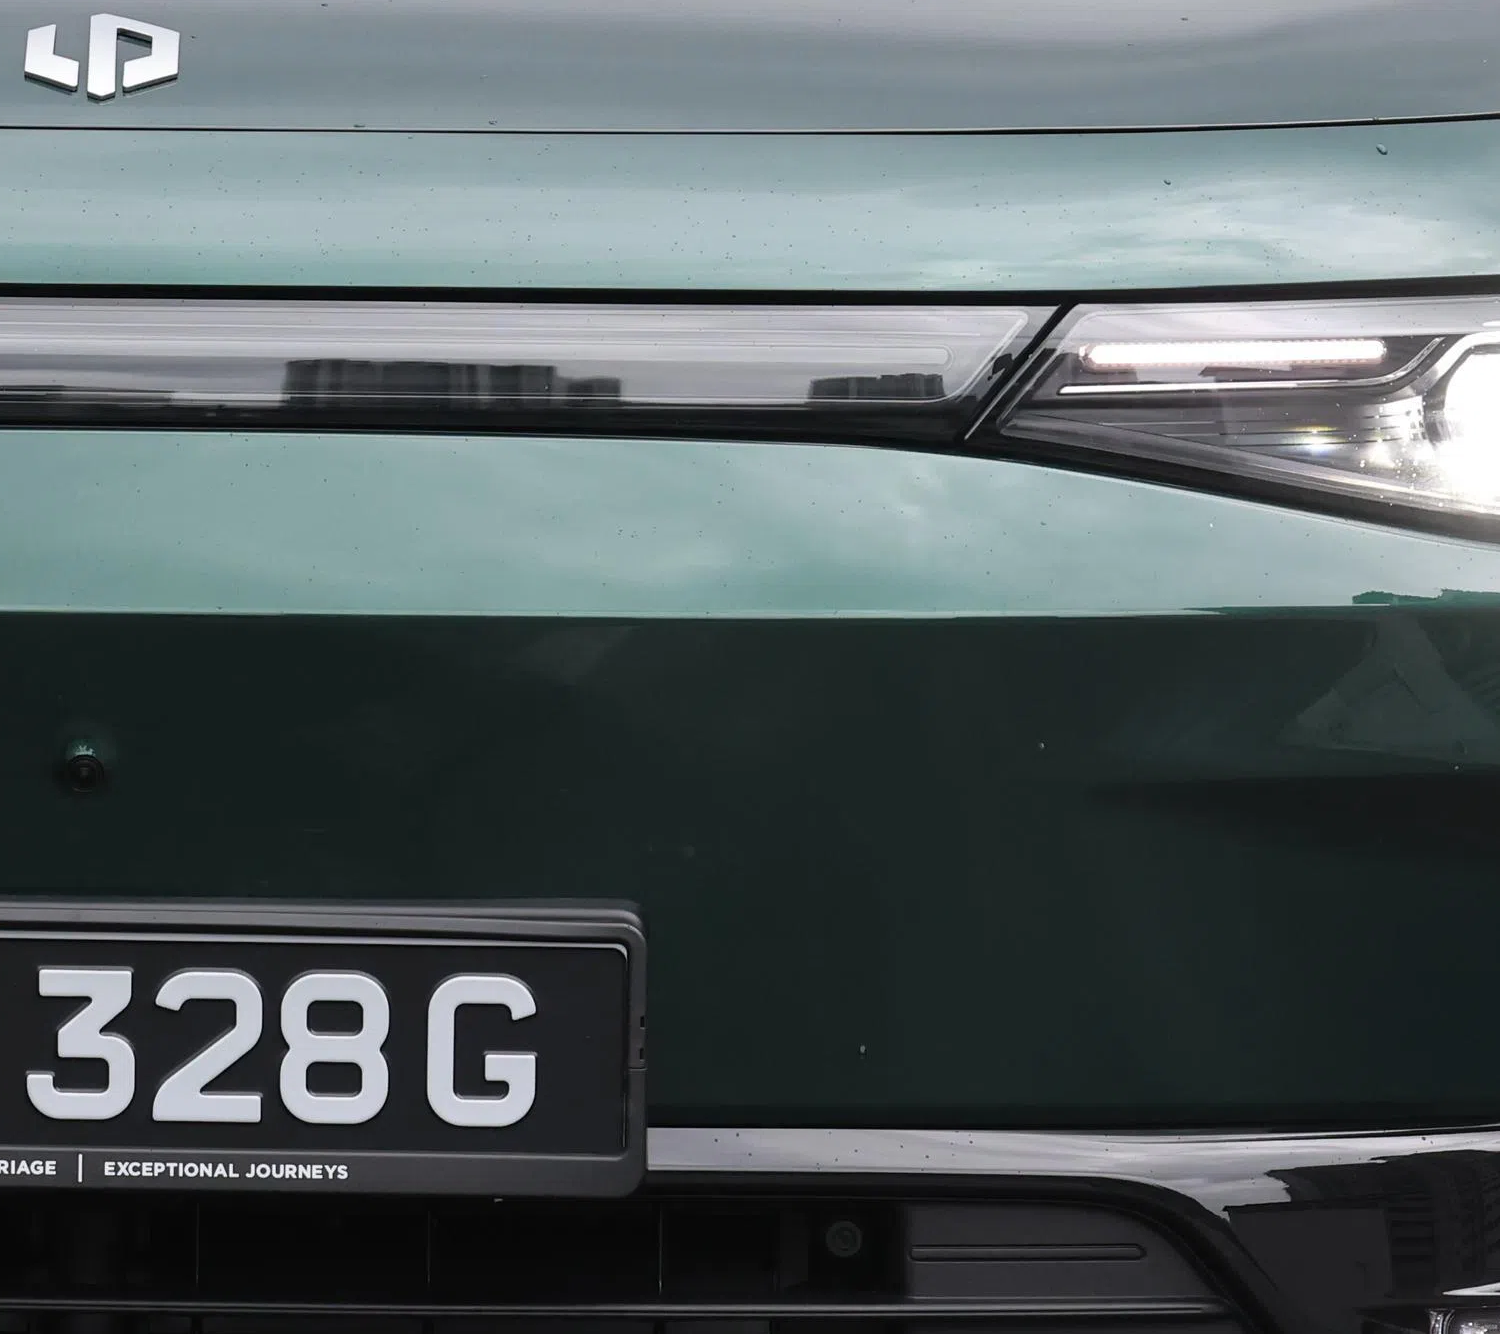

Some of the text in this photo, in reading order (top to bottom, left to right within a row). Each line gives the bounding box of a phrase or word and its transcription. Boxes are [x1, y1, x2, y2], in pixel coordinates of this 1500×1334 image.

[25, 967, 538, 1127] 328G
[103, 1161, 240, 1178] EXCEPTIONAL
[245, 1163, 349, 1180] JOURNEYS
